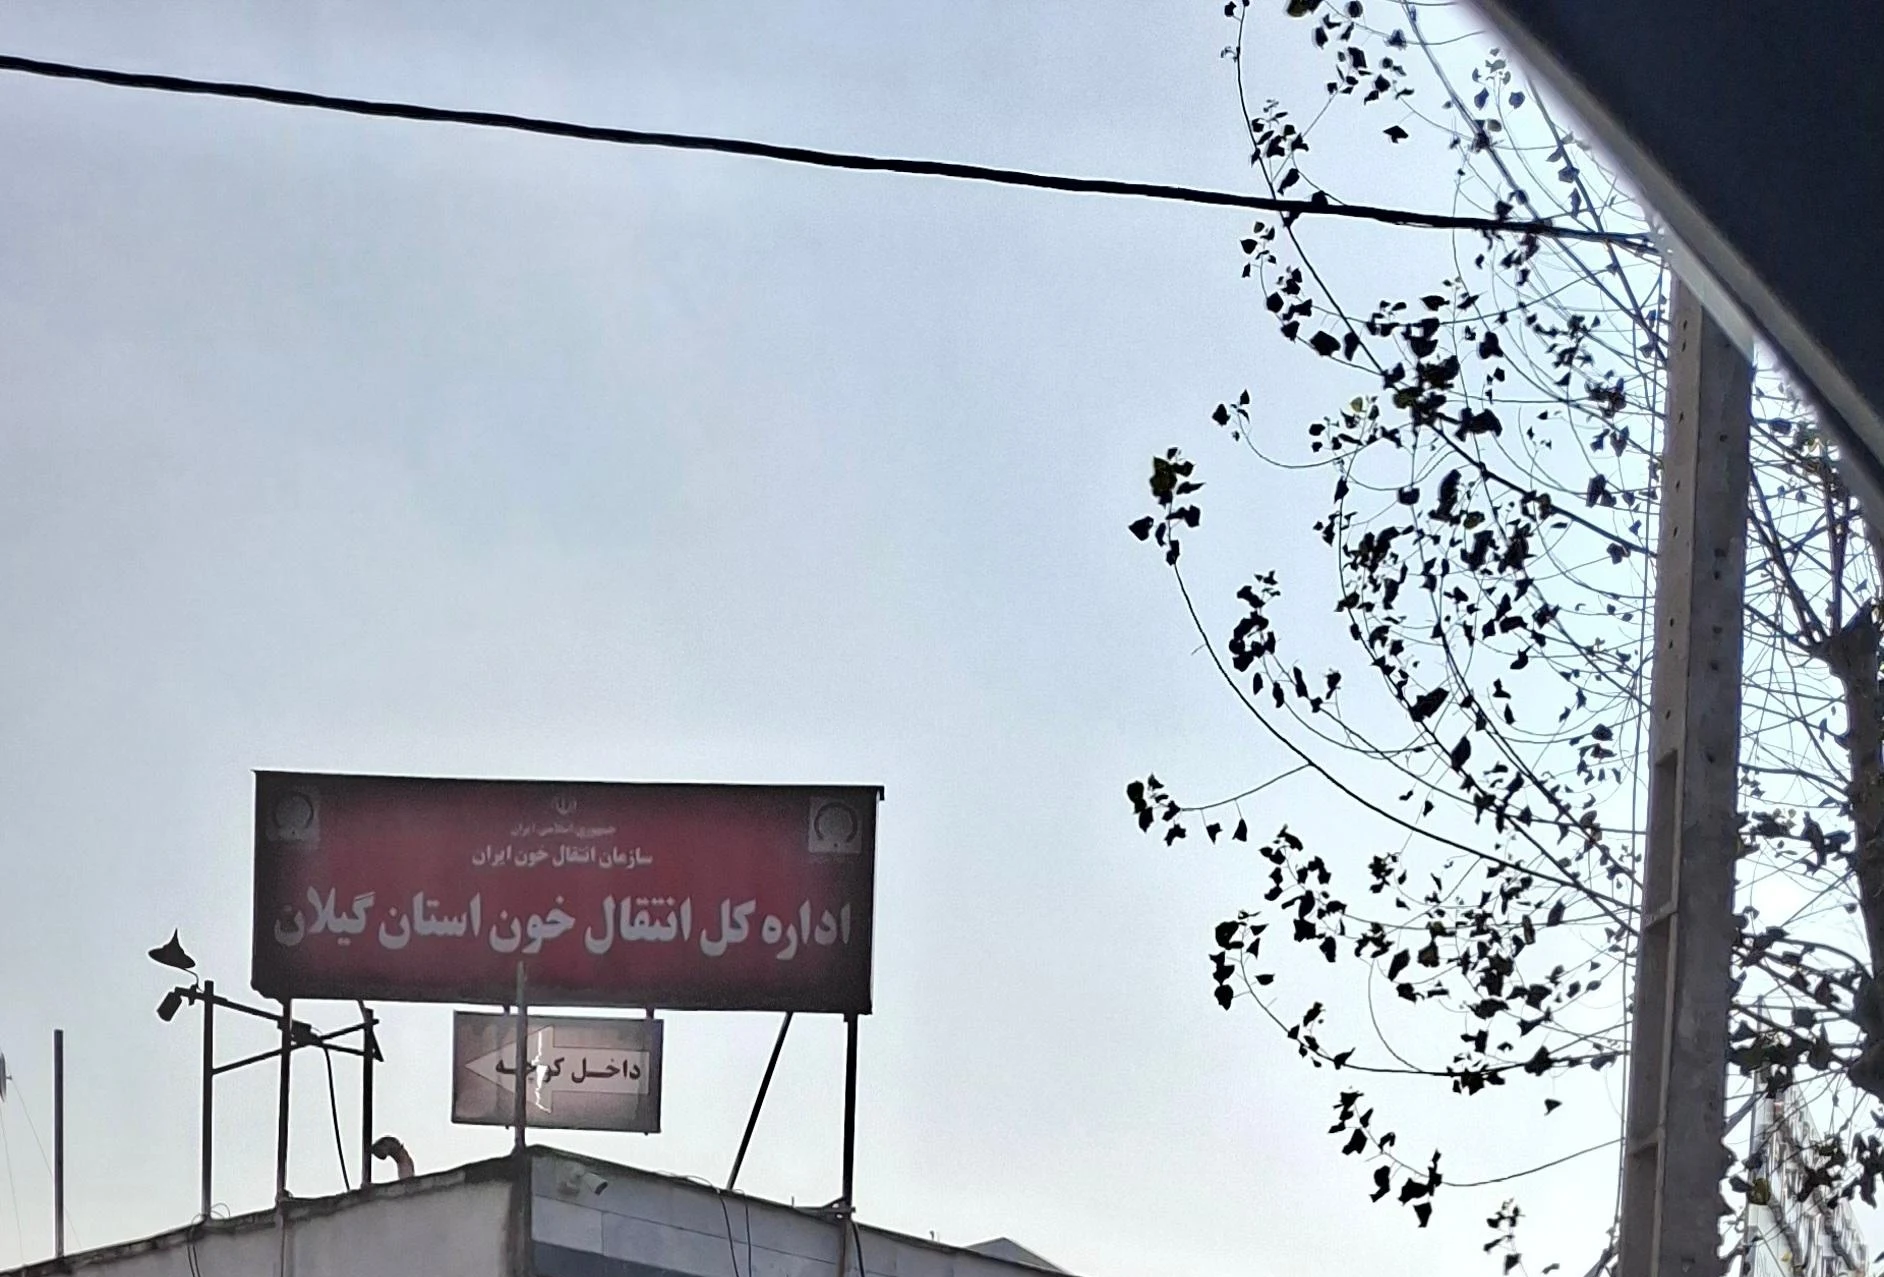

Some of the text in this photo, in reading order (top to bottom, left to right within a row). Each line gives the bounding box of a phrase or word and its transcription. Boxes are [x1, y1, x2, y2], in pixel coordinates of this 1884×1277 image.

[471, 843, 654, 870] سازمان انتقال خون ایران
[273, 885, 851, 961] اداره کل انتقال خون استان گیلان
[571, 1057, 641, 1084] داخل
